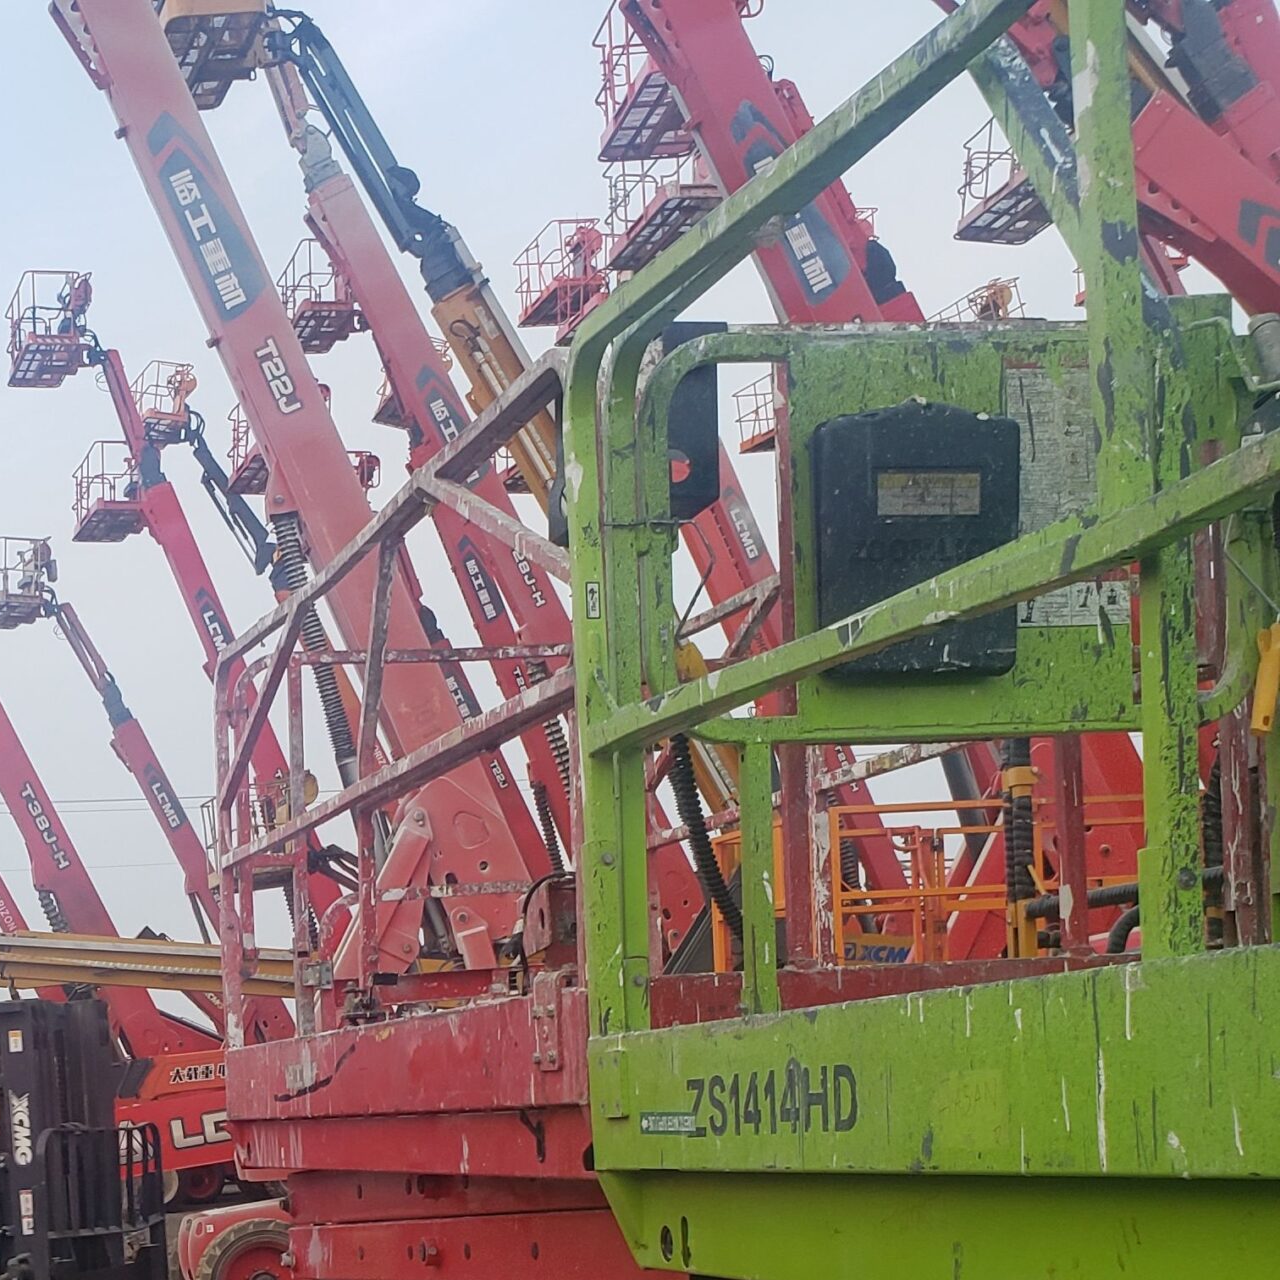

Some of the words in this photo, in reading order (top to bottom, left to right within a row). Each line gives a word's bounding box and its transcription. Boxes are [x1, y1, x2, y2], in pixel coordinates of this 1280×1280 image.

[169, 168, 247, 311] 临工重机
[254, 336, 302, 414] T22J
[512, 550, 546, 607] 28J-H
[20, 781, 70, 870] T38J-H
[8, 1088, 33, 1166] XCMG
[686, 1064, 858, 1138] ZS1414HD
